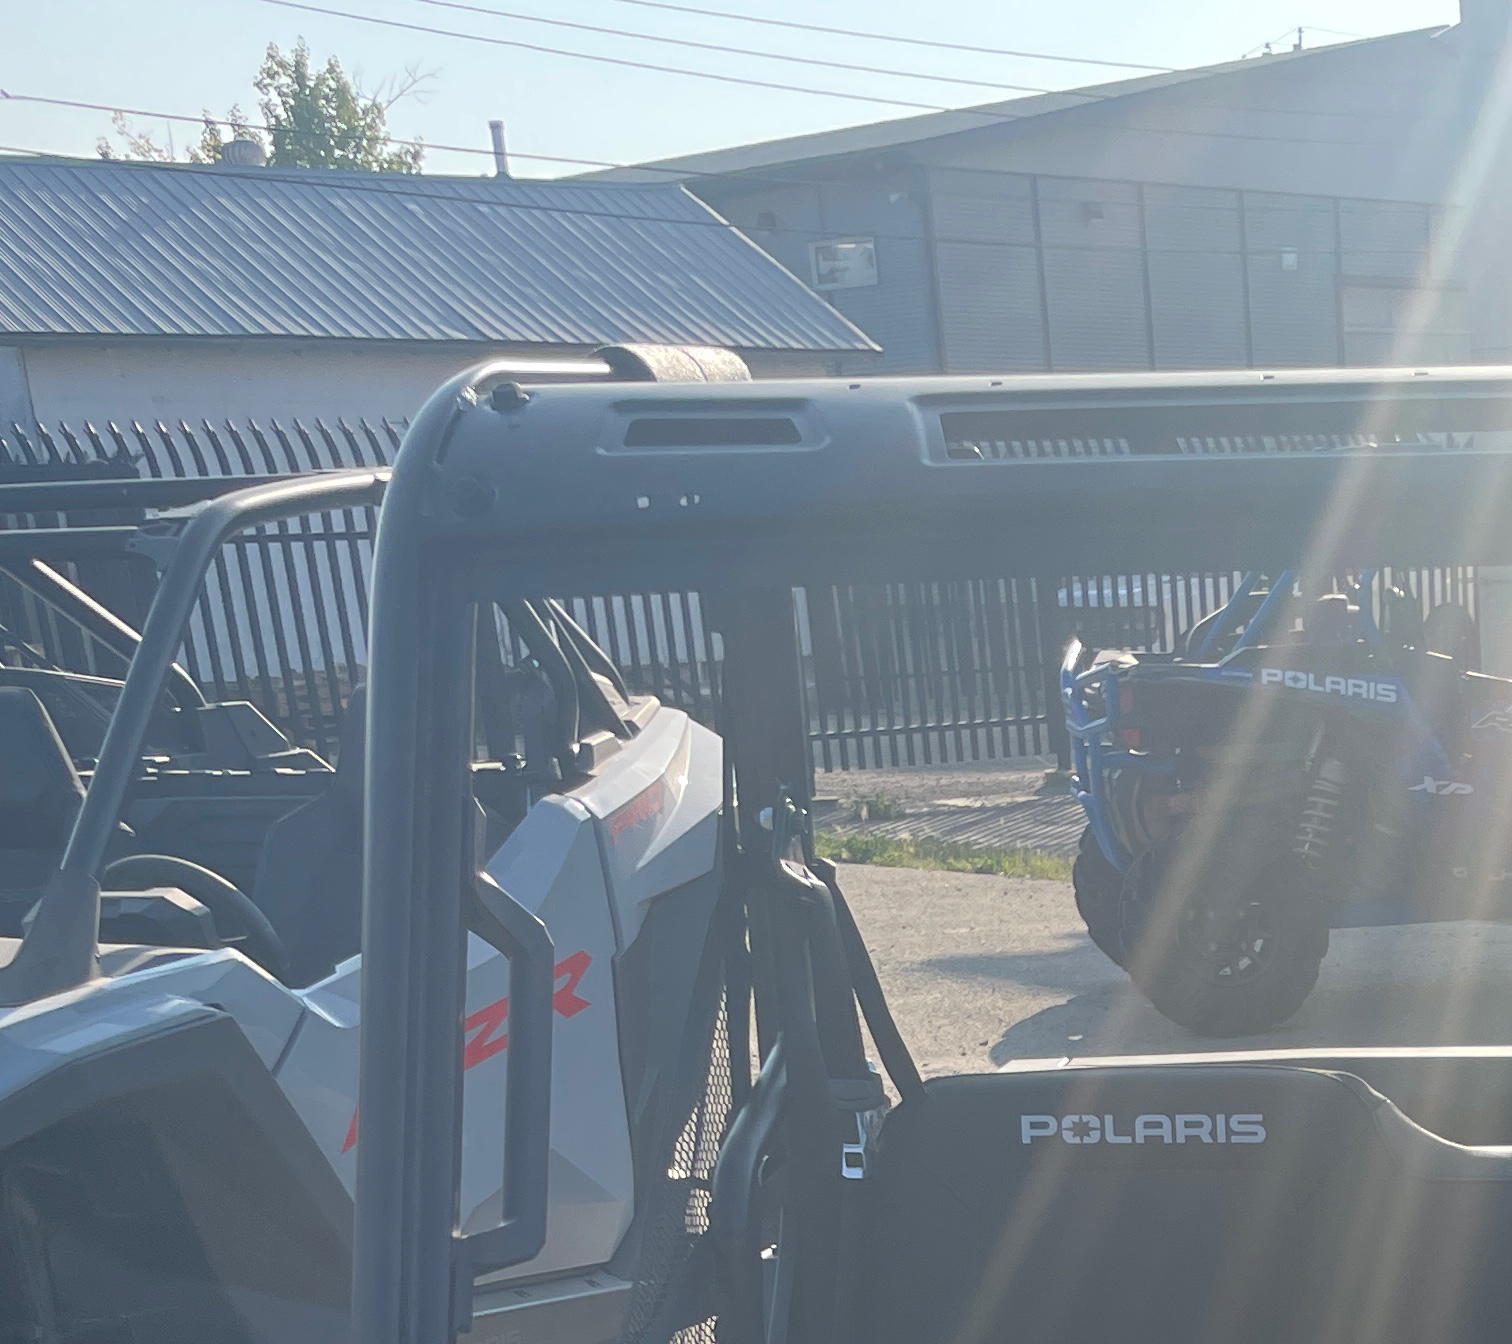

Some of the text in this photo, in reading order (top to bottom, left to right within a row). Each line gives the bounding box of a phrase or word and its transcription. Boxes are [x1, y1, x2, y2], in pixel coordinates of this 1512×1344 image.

[1261, 668, 1398, 703] POLARIS
[1407, 776, 1475, 795] XP
[1021, 1114, 1267, 1144] POLARIS
